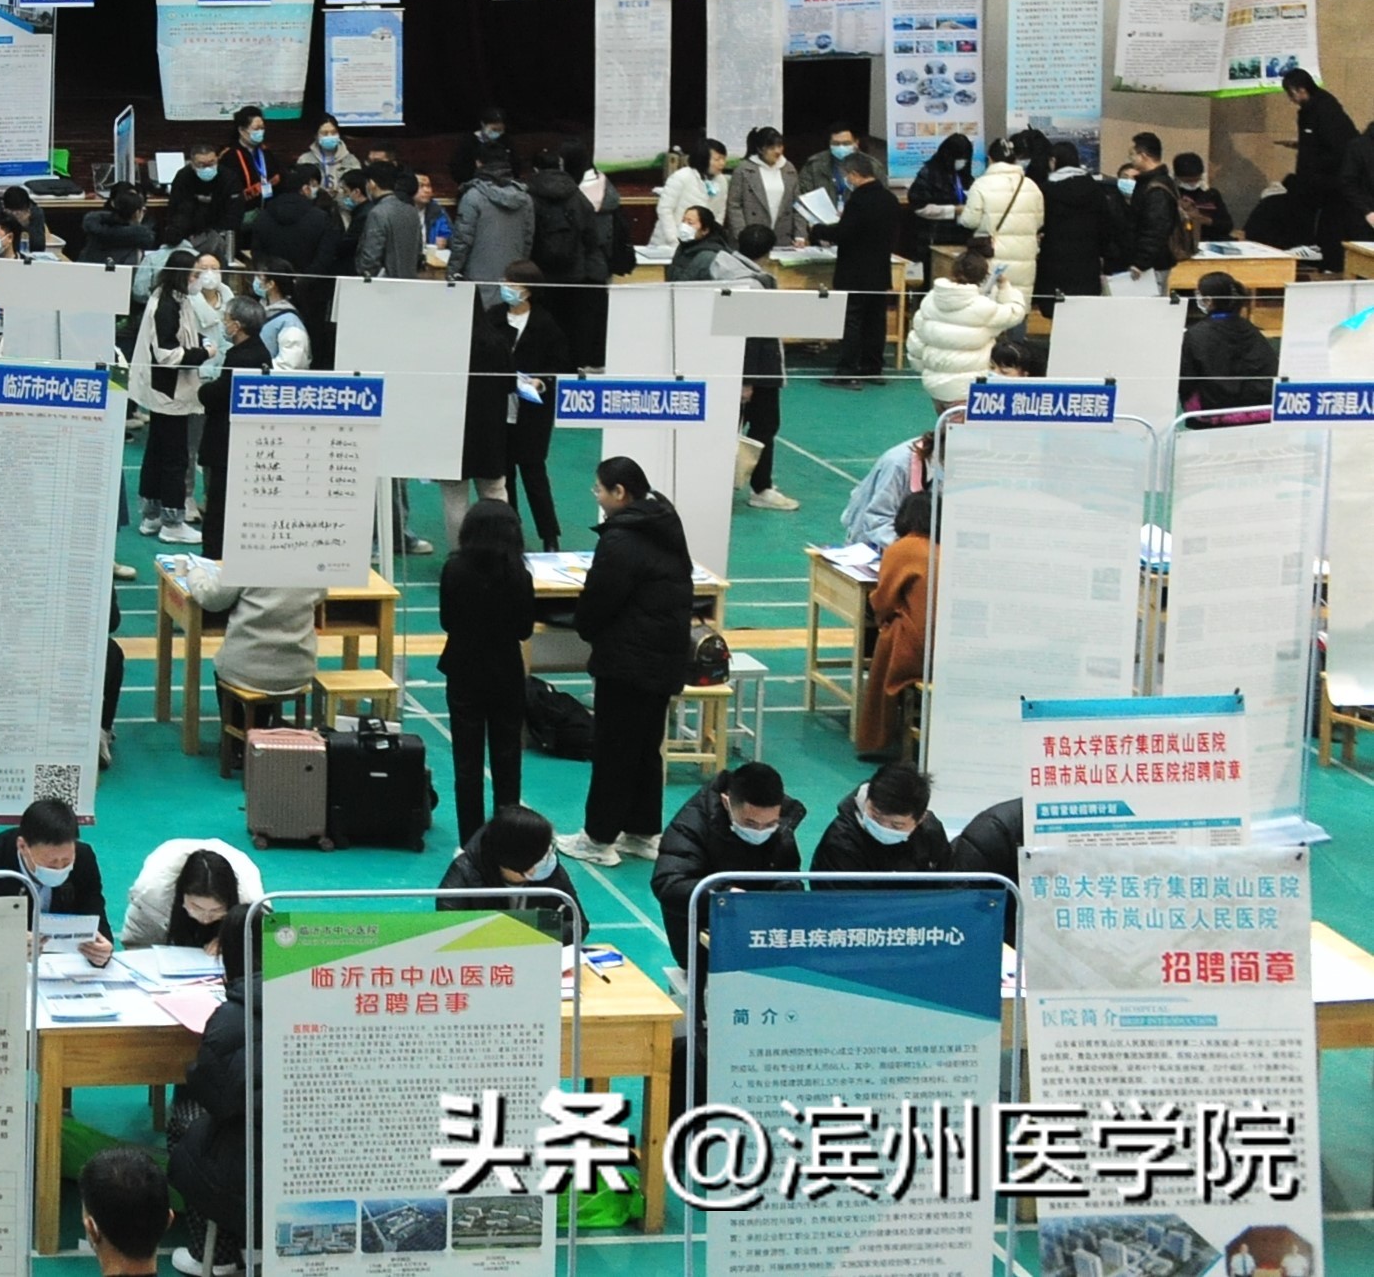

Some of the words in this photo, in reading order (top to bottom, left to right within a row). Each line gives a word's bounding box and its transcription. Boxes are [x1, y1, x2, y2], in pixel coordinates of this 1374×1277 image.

[3, 374, 102, 404] 临沂市中心医院
[238, 384, 377, 412] 五莲县疾控中心
[561, 389, 595, 413] Z063
[601, 389, 701, 415] 日照市岚山区人民医院
[970, 392, 1006, 415] Z064
[1011, 391, 1110, 418] 微山县人民医院
[1277, 391, 1312, 414] Z065
[1316, 391, 1374, 415] 沂源县人
[1042, 731, 1226, 758] 青岛大学医疗集团岚山医院
[1030, 759, 1241, 787] 日照市岚山区人民医院招聘简章
[1030, 875, 1300, 899] 青岛大学医疗集团岚山医院
[299, 925, 379, 936] 临沂市中心医院
[1055, 907, 1279, 930] 日照市岚山区人民医院
[748, 926, 965, 949] 五莲县疾病预防控制中心
[310, 964, 515, 989] 临沂市中心医院
[1161, 951, 1295, 984] 招聘简章
[355, 992, 470, 1015] 招聘启事
[732, 1008, 778, 1025] 简介
[1041, 1008, 1118, 1027] 医院简介
[293, 1024, 328, 1034] 医院简介
